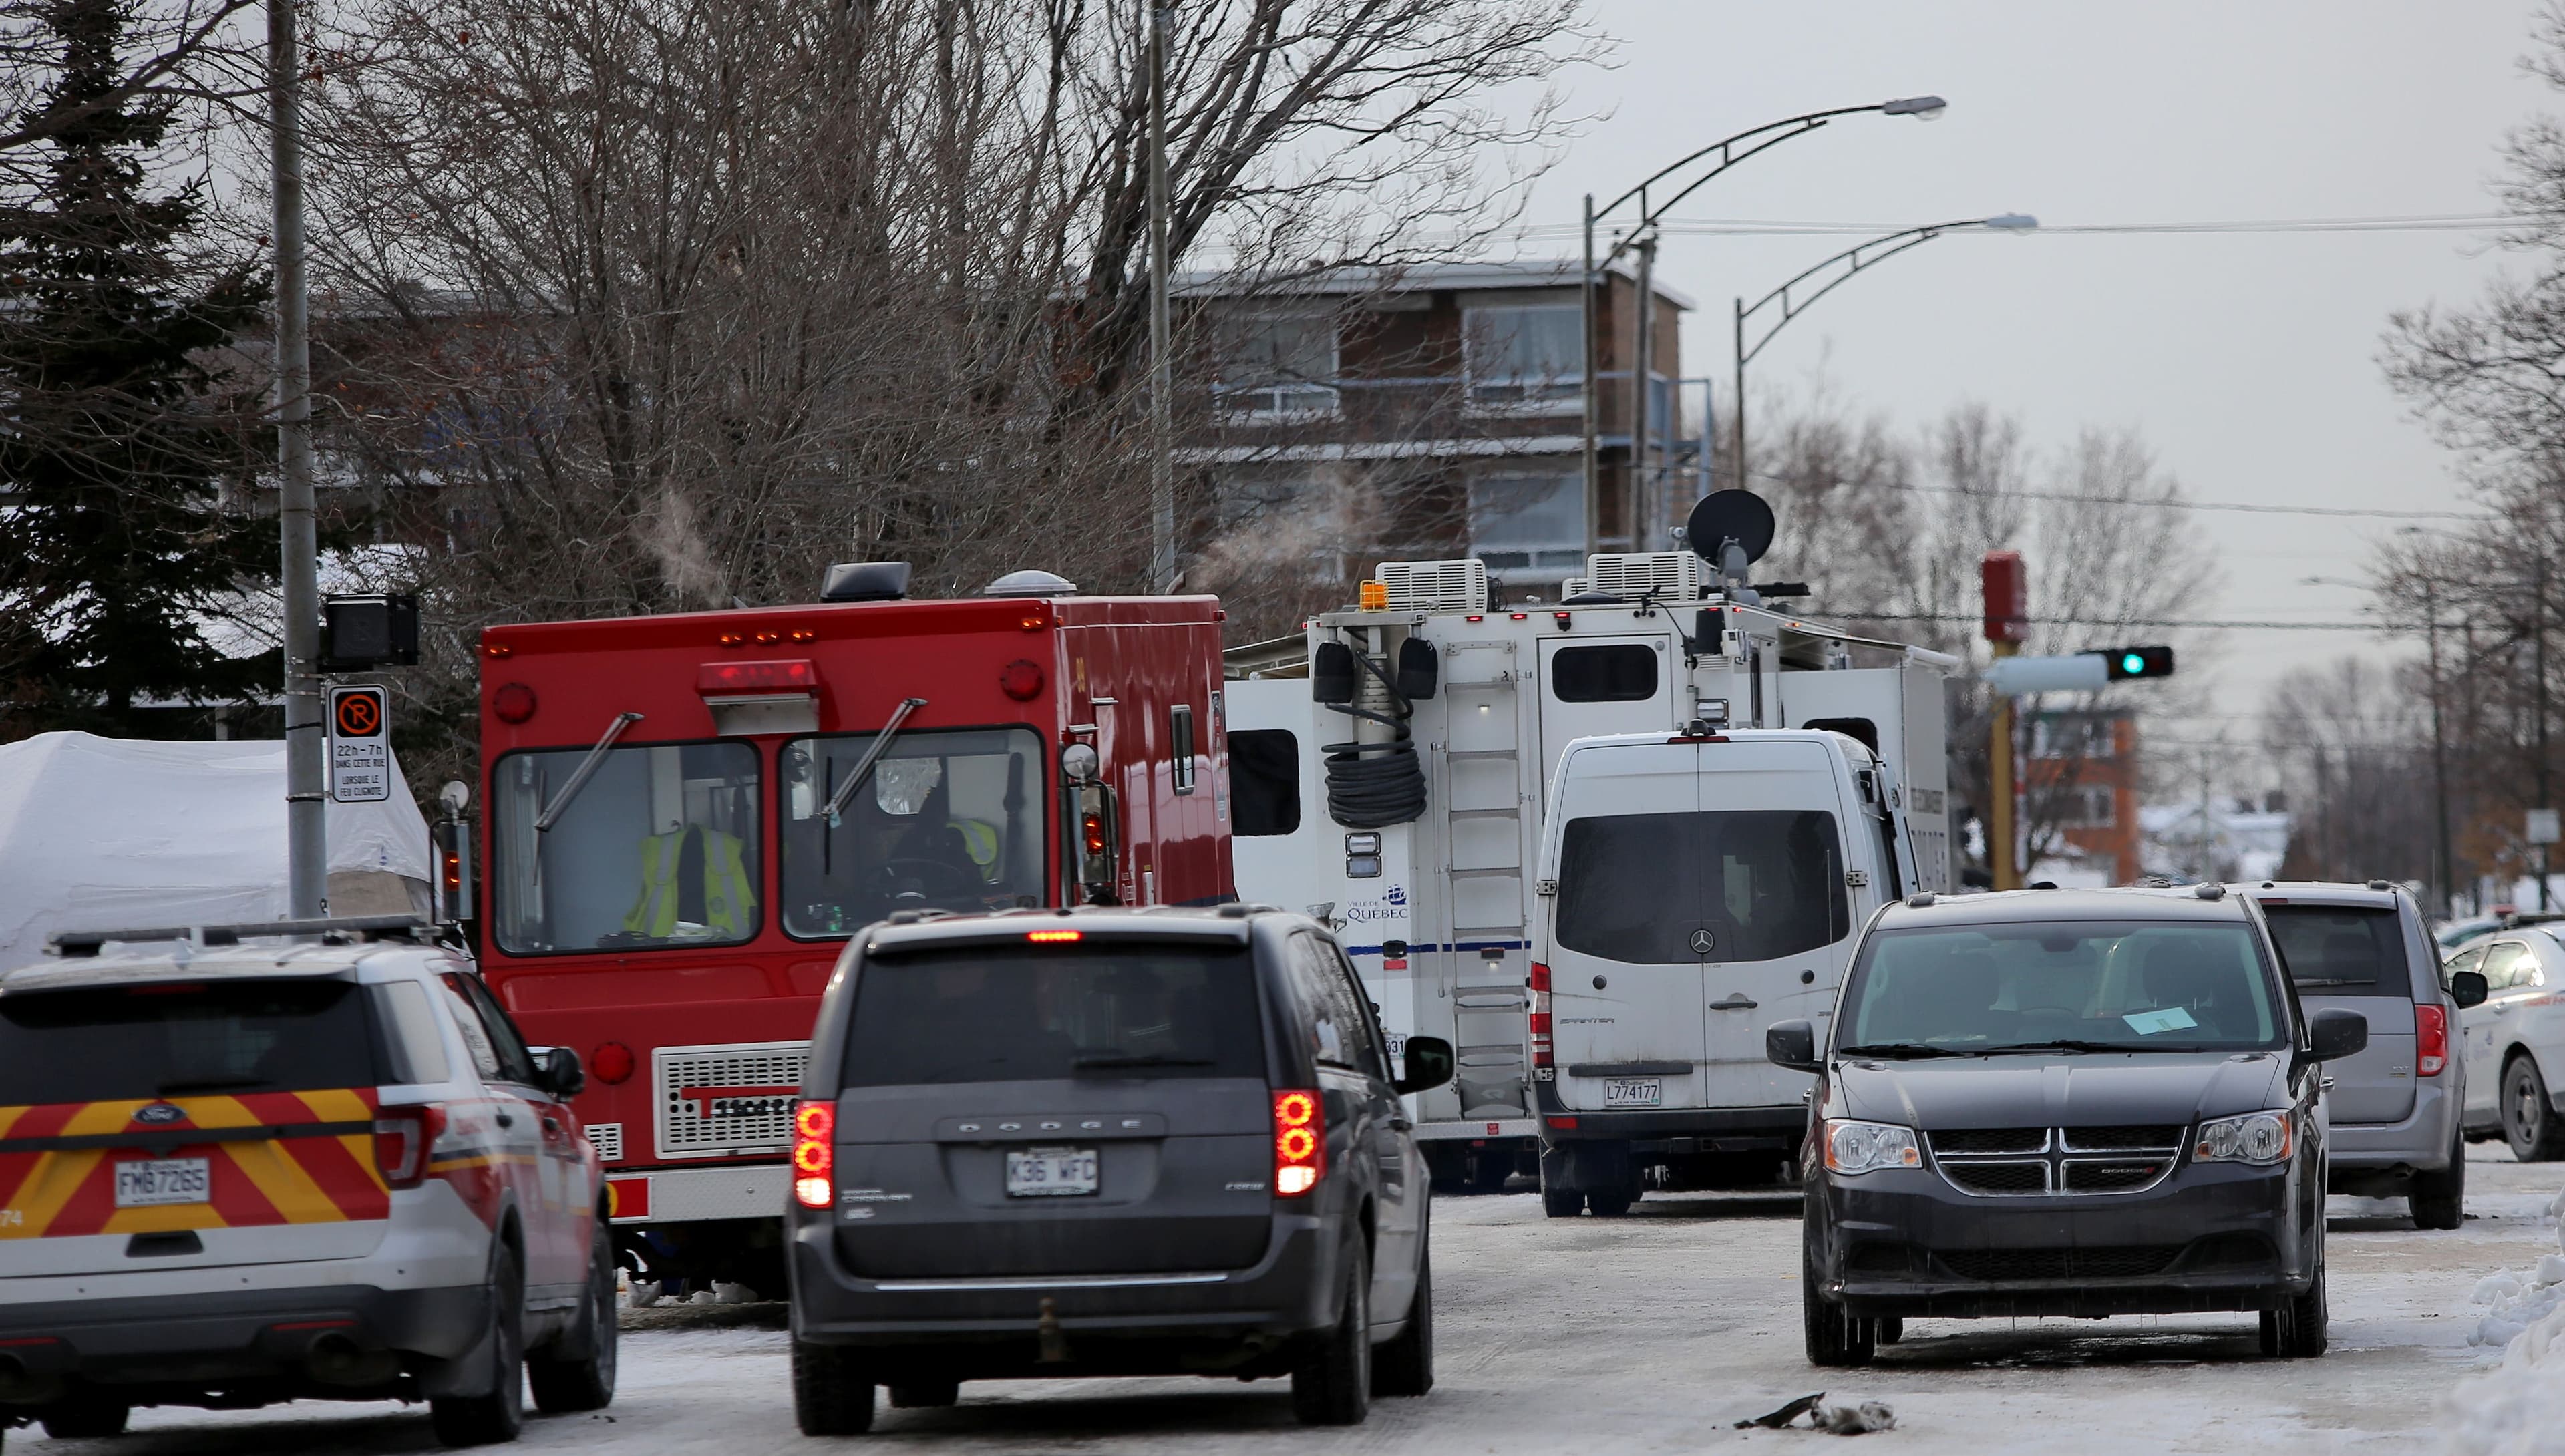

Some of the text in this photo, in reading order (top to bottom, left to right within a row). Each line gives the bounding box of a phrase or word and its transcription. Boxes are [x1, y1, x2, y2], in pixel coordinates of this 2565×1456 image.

[335, 758, 385, 769] DANS CETTE RUE
[341, 775, 379, 785] LORSQUE LE
[339, 787, 383, 797] FEU CLIGNOTE
[1347, 907, 1408, 924] QUÉBEC
[1606, 1085, 1657, 1100] L774177
[957, 1119, 1142, 1133] DODGE
